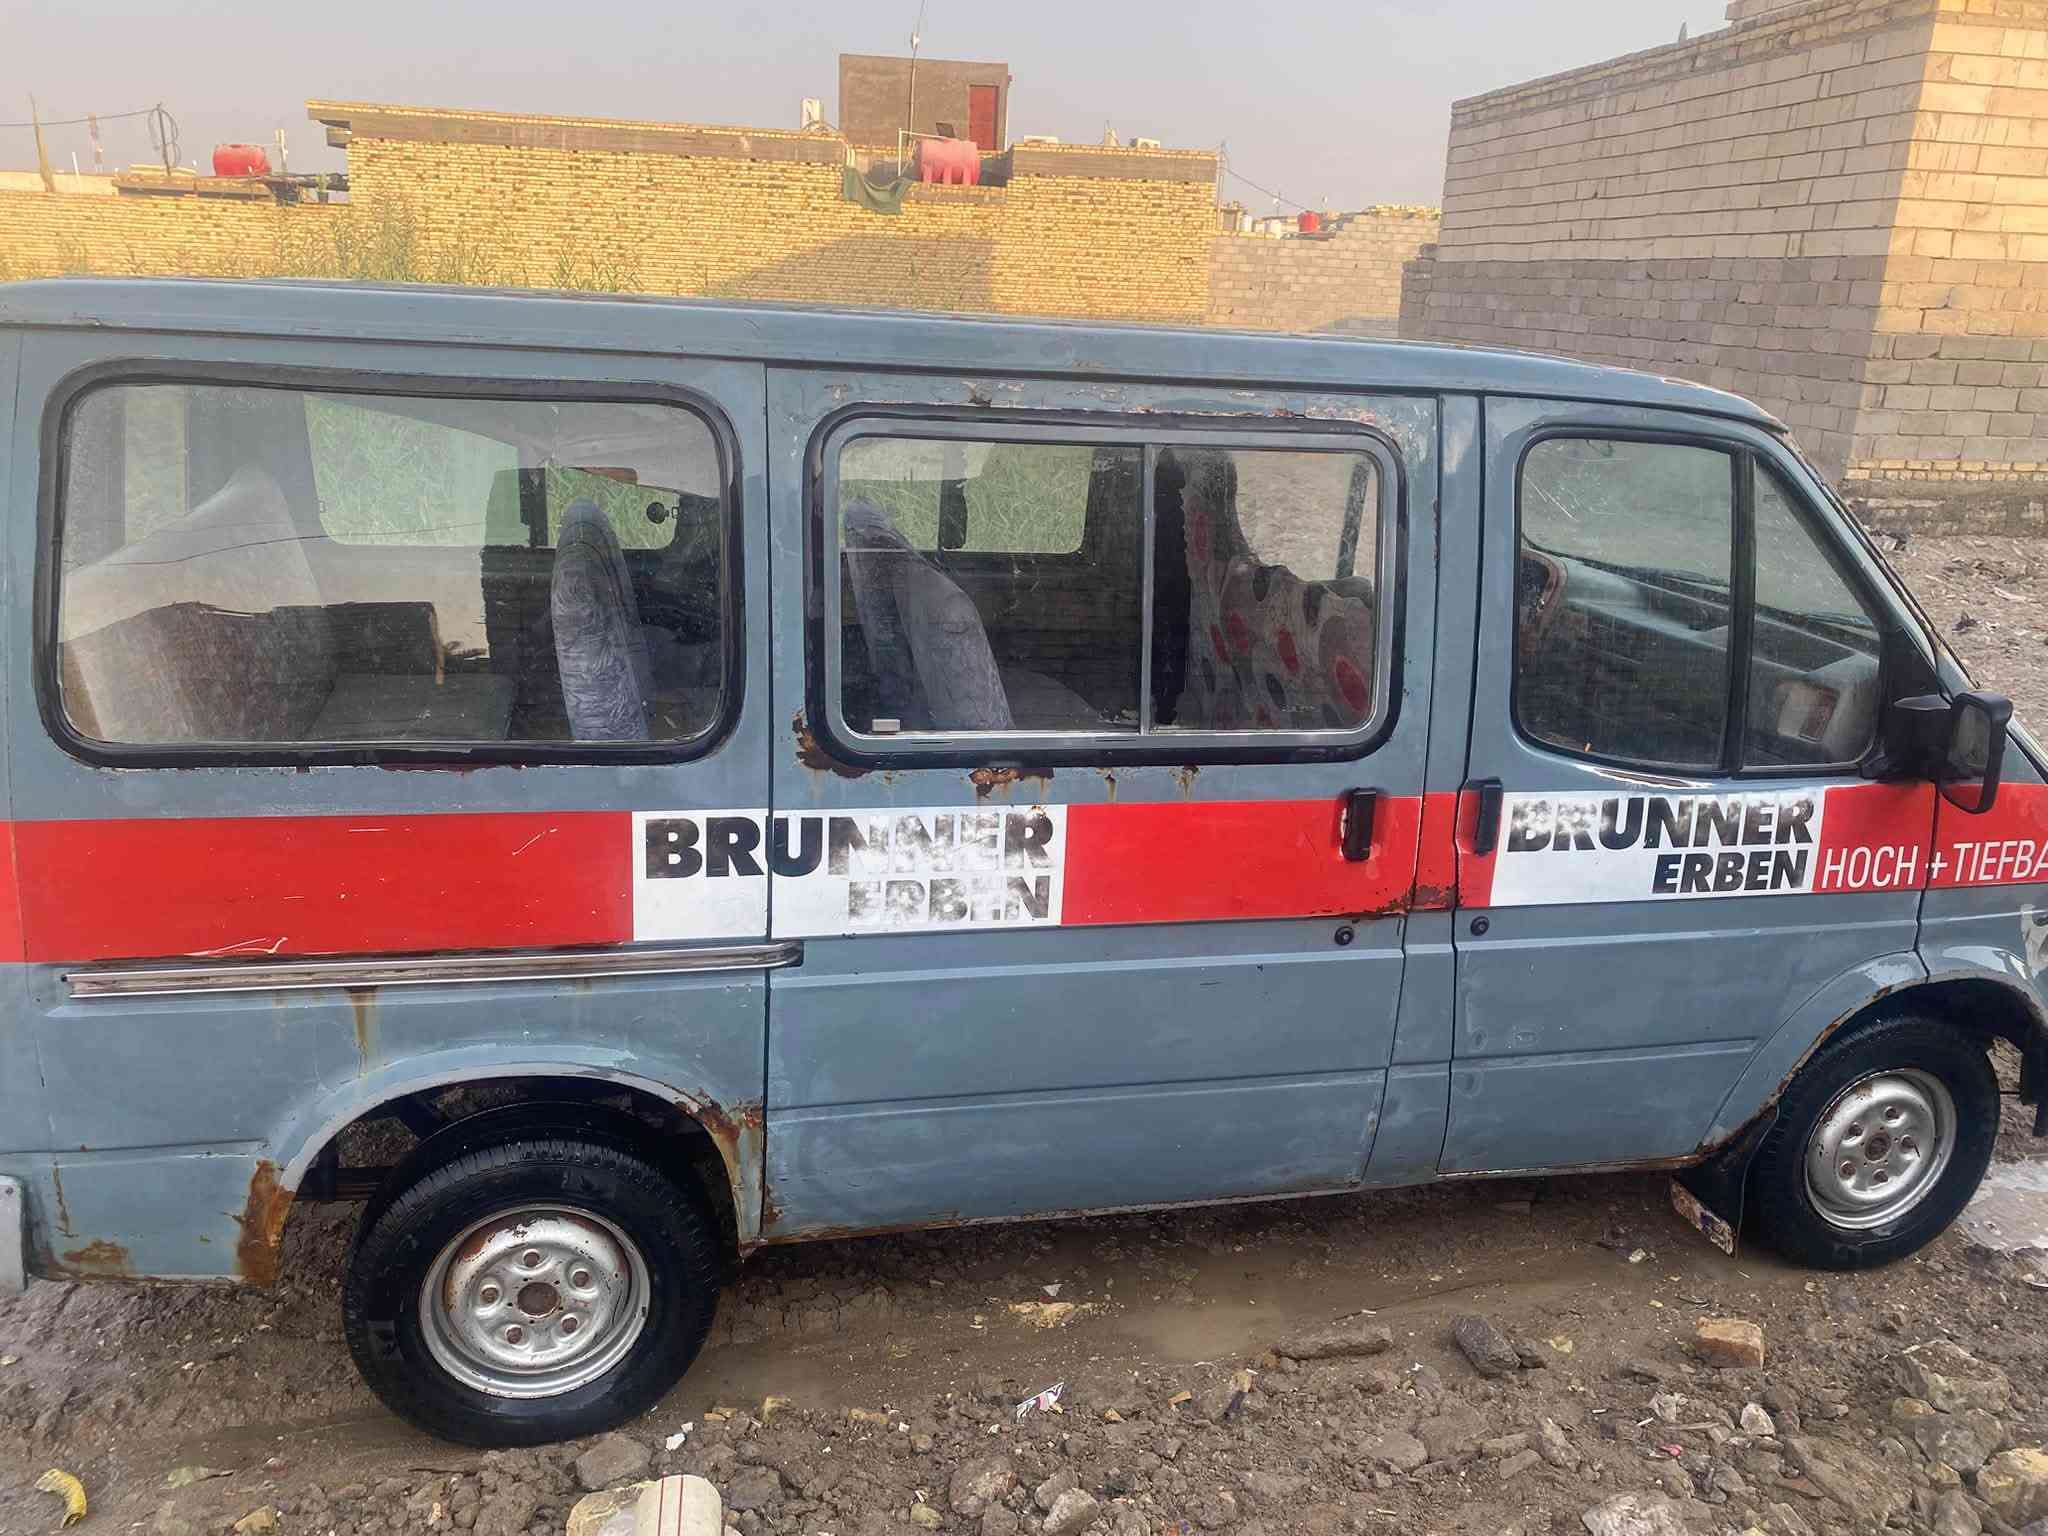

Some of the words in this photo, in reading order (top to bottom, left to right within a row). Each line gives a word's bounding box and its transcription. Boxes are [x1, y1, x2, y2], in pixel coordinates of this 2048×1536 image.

[645, 813, 1054, 879] BRUNNER
[1506, 797, 1815, 853] BRUNNER
[1651, 851, 1809, 893] ERBEN
[1822, 844, 1917, 889] HOCH
[847, 876, 1050, 922] ERBEN
